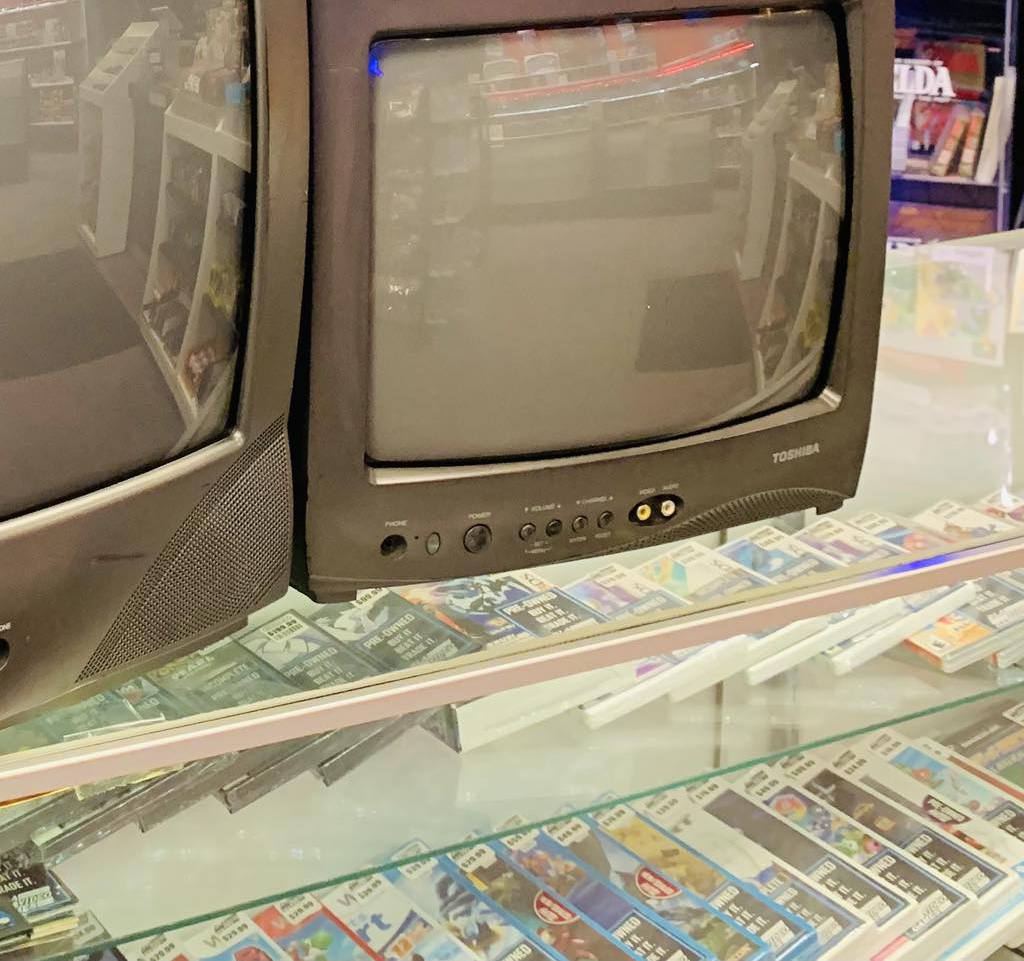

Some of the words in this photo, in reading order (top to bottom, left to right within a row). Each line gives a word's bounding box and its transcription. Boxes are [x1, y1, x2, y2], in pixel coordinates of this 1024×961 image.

[772, 442, 820, 464] TOSHIBA
[384, 519, 408, 528] PHONE
[468, 511, 493, 520] POWER
[502, 591, 558, 616] PRE-OWNED
[527, 605, 546, 617] BUY
[535, 611, 557, 624] BEAT
[543, 617, 572, 629] TRADE
[363, 612, 416, 650] PRE-OWNED
[386, 631, 404, 647] BUY
[393, 636, 416, 655] BEAT
[400, 643, 428, 661] TRADE
[284, 645, 339, 679] PRE-OWNED
[306, 663, 325, 678] BUY
[313, 670, 335, 686] BEAT
